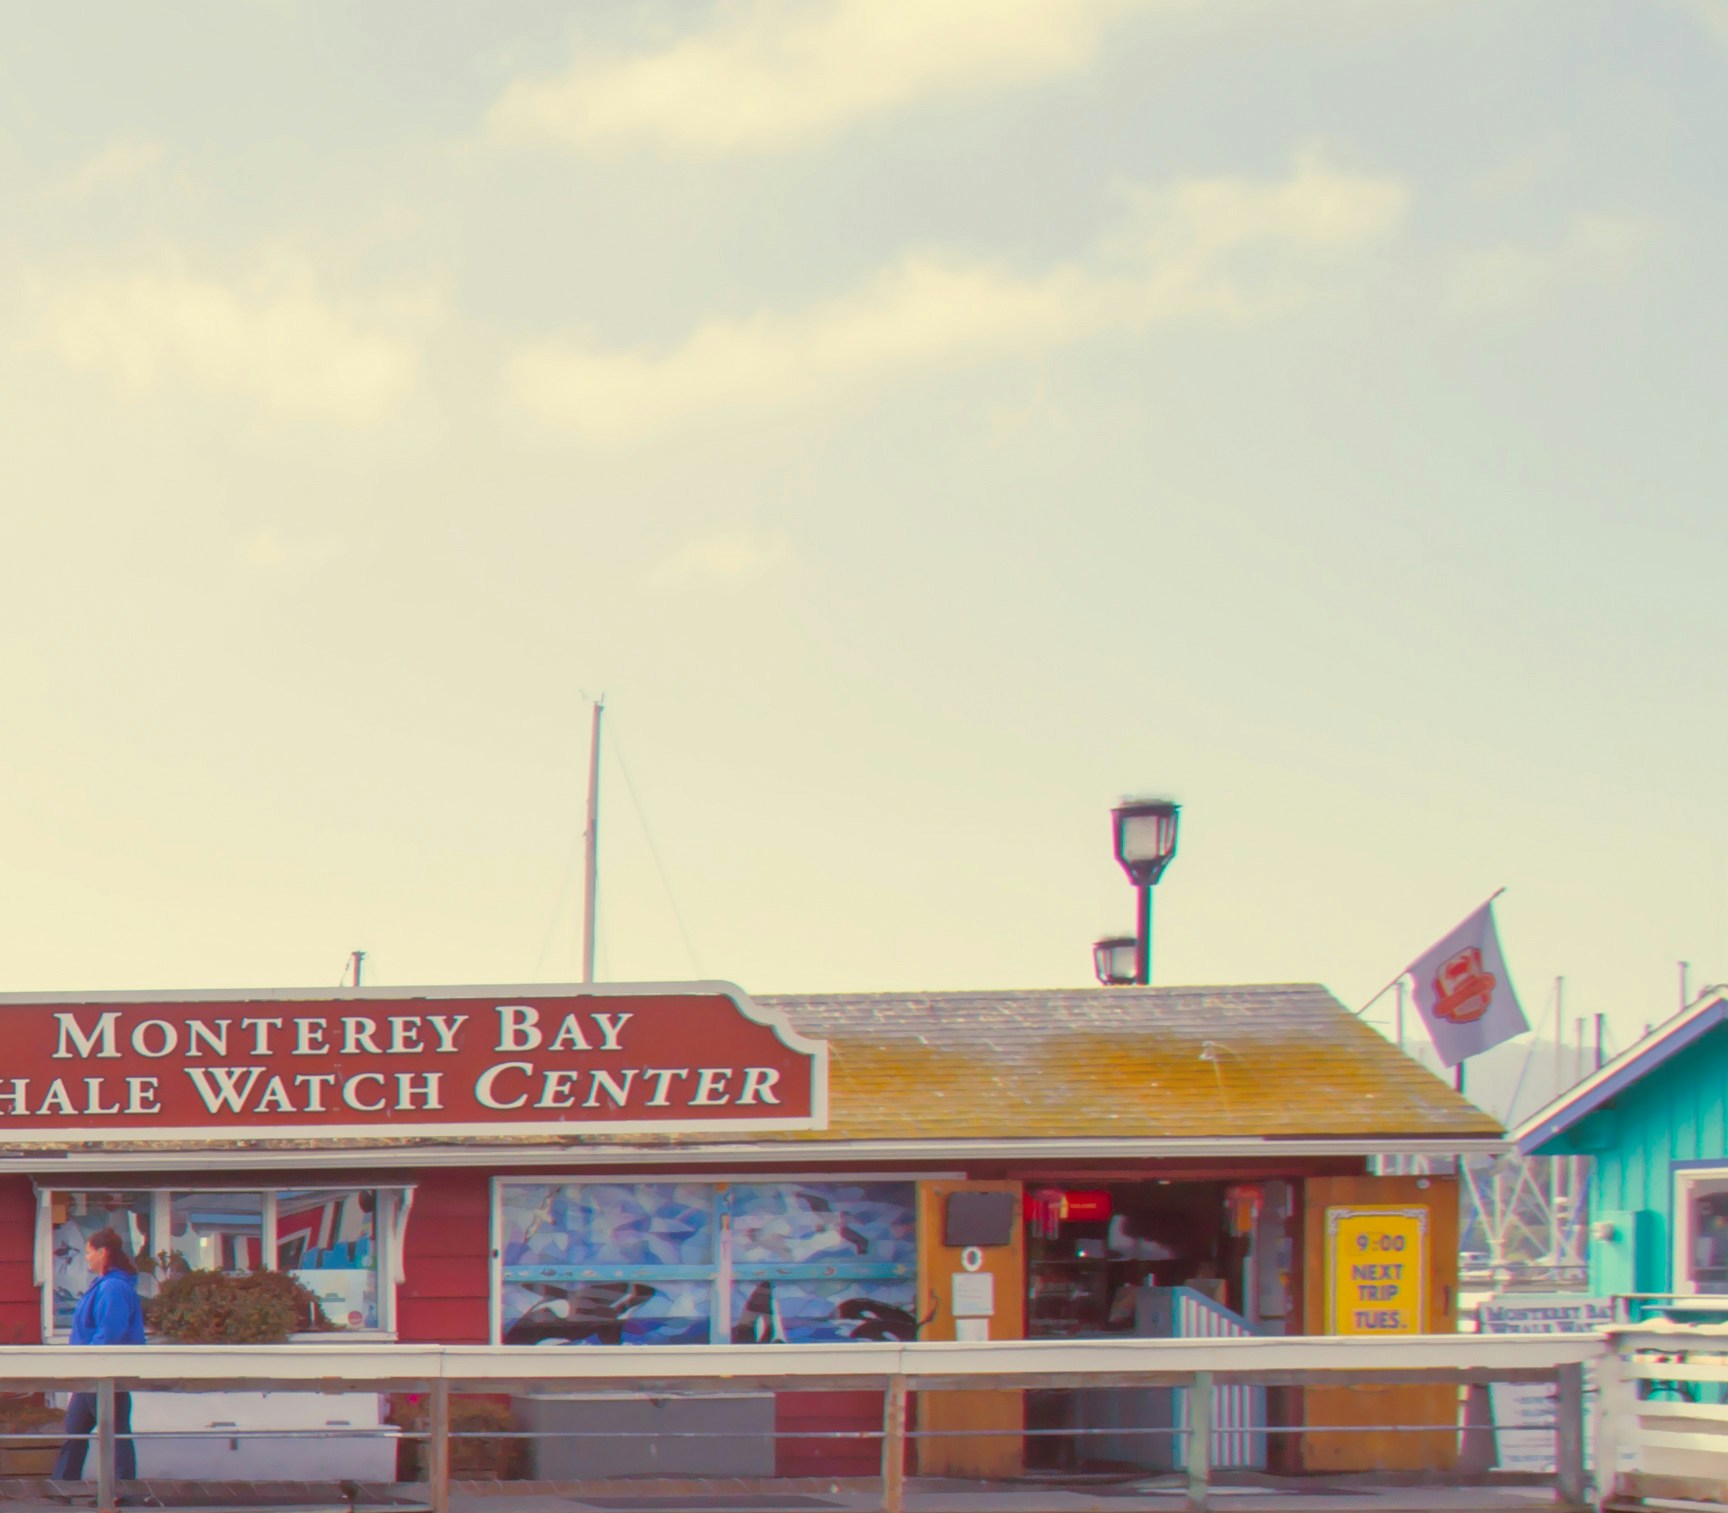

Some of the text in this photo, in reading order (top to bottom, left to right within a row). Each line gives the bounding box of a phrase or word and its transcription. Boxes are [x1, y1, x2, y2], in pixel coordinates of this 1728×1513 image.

[51, 1004, 634, 1060] MONTEREY BAY
[182, 1065, 445, 1115] WATCH
[473, 1061, 782, 1110] CENTER
[1351, 1264, 1404, 1281] NEXT
[1357, 1284, 1400, 1301] TRIP
[1355, 1310, 1408, 1329] TUES.
